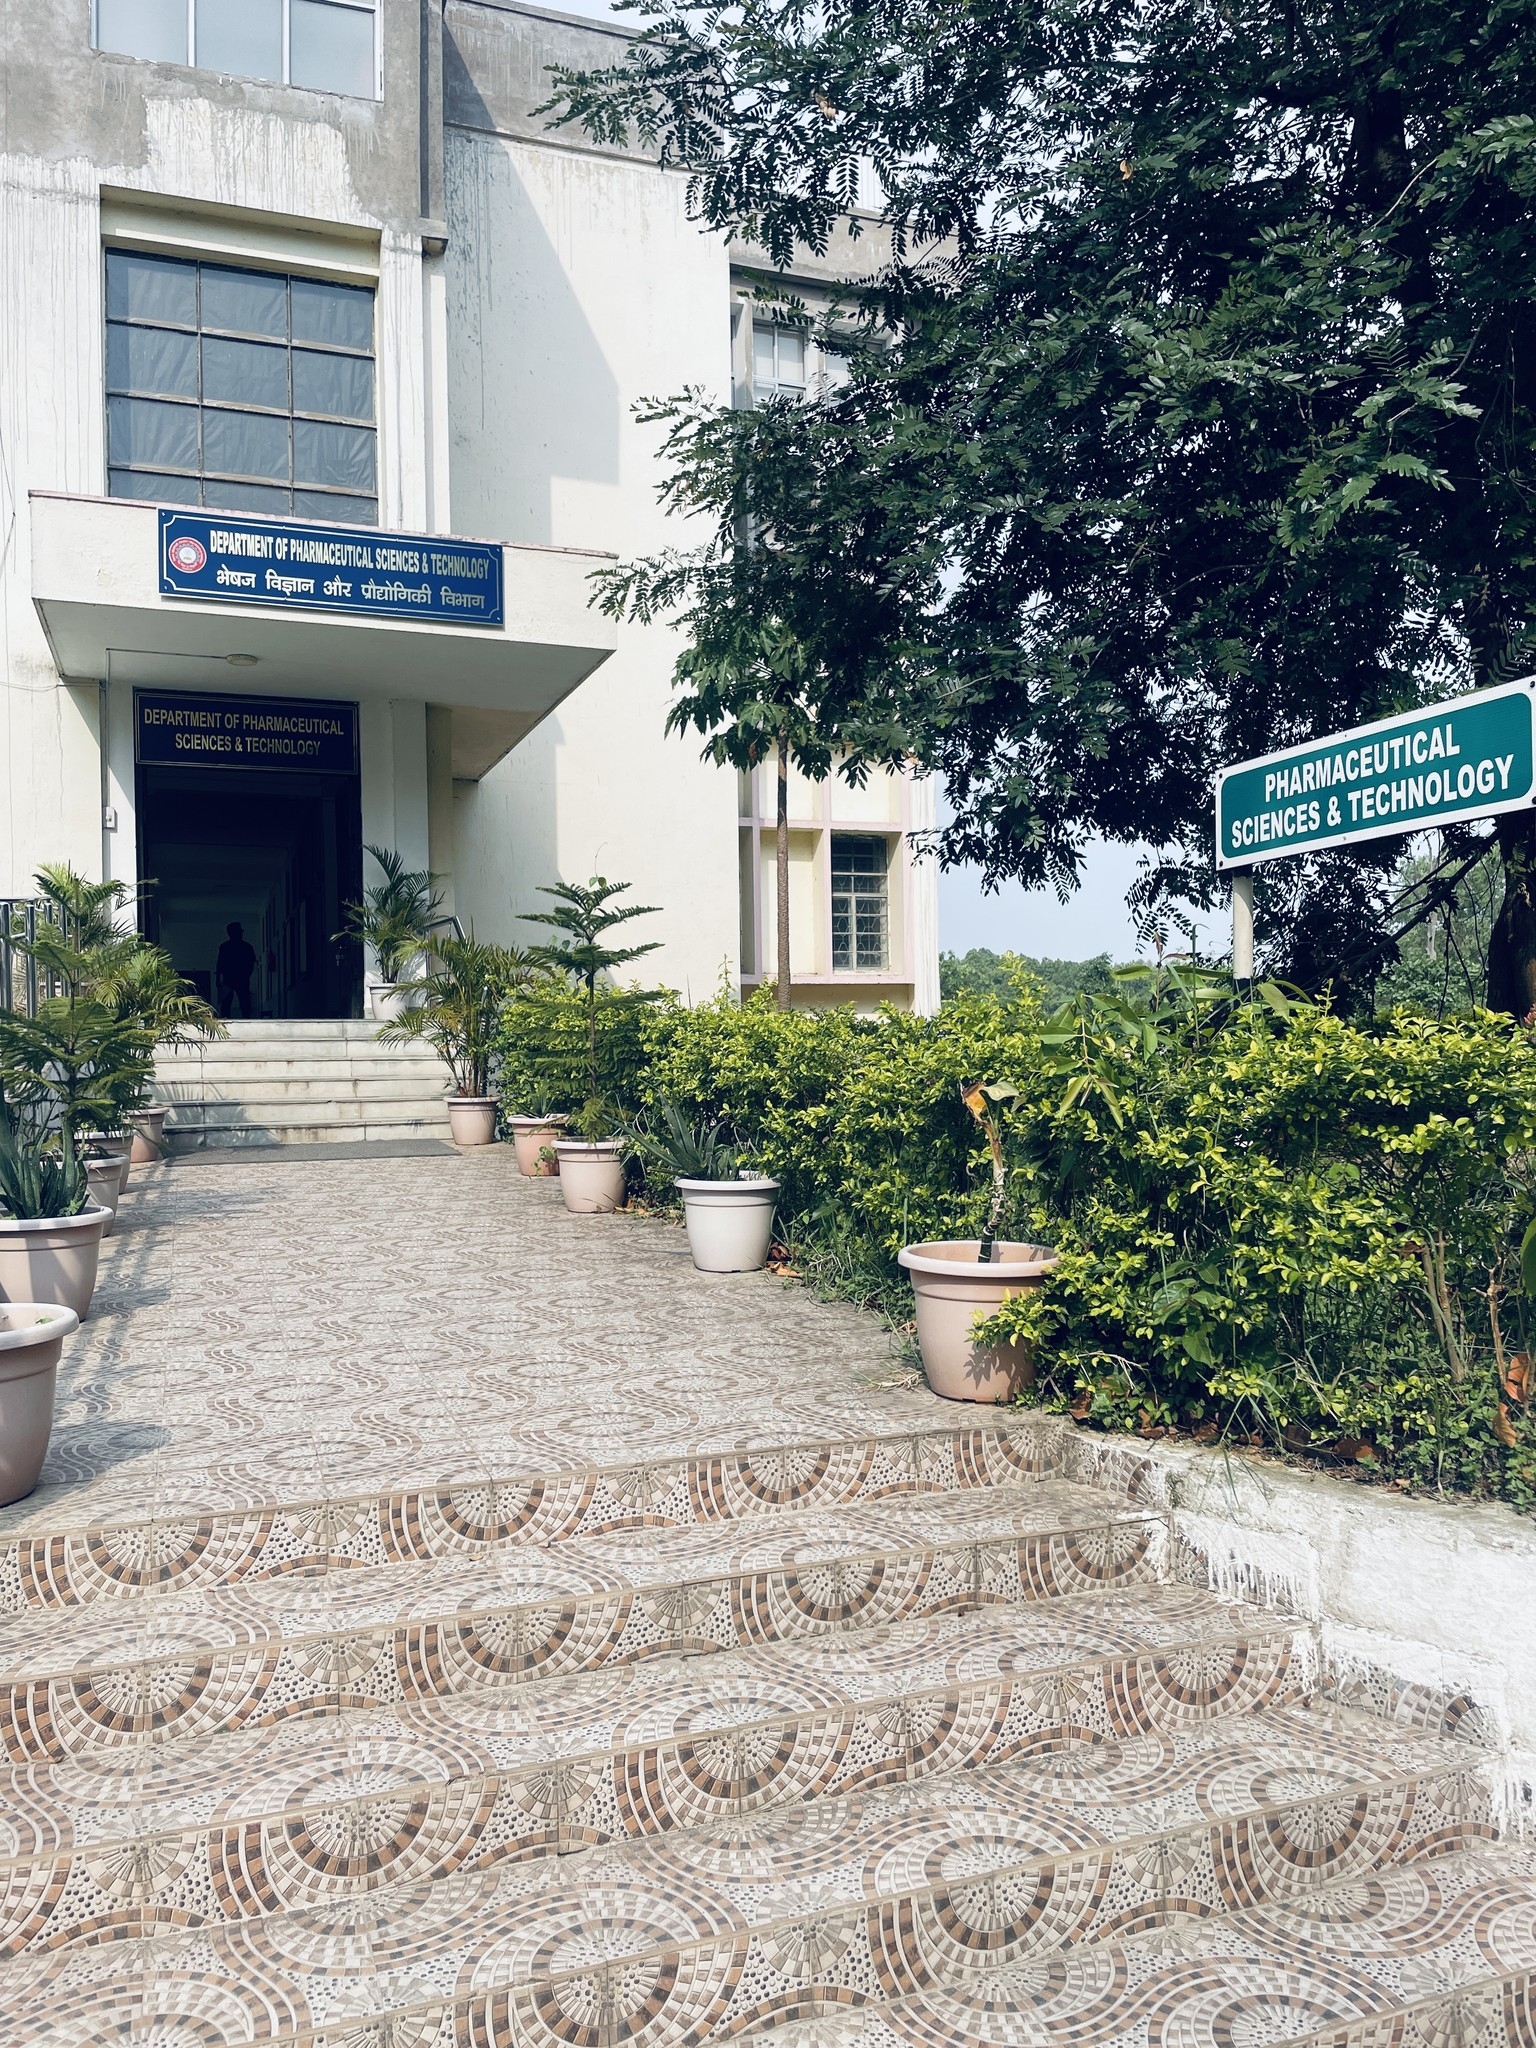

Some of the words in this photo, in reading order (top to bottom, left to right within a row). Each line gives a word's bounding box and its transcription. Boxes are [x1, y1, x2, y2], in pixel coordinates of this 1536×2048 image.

[210, 530, 273, 558] DEPARTMENT
[275, 538, 288, 560] OF
[290, 539, 373, 569] PHARMACEUTICAL
[375, 549, 419, 573] SCIENCES
[421, 553, 428, 574] &
[430, 554, 490, 580] TECHNOLOGY
[216, 564, 256, 588] भेषज
[265, 568, 314, 596] विज्ञान
[323, 575, 351, 598] और
[440, 586, 485, 609] विभाग
[144, 708, 221, 728] DEPARTMENT
[224, 713, 239, 729] OF
[243, 714, 344, 735] PHARMACEUTICAL
[175, 733, 231, 751] SCIENCES
[235, 738, 243, 752] &
[246, 737, 320, 755] TECHNOLOGY
[1265, 723, 1460, 802] PHARMACEUTICAL
[1231, 800, 1321, 849] SCIENCES
[1327, 795, 1342, 826] &
[1348, 754, 1514, 822] TECHNOLOGY
